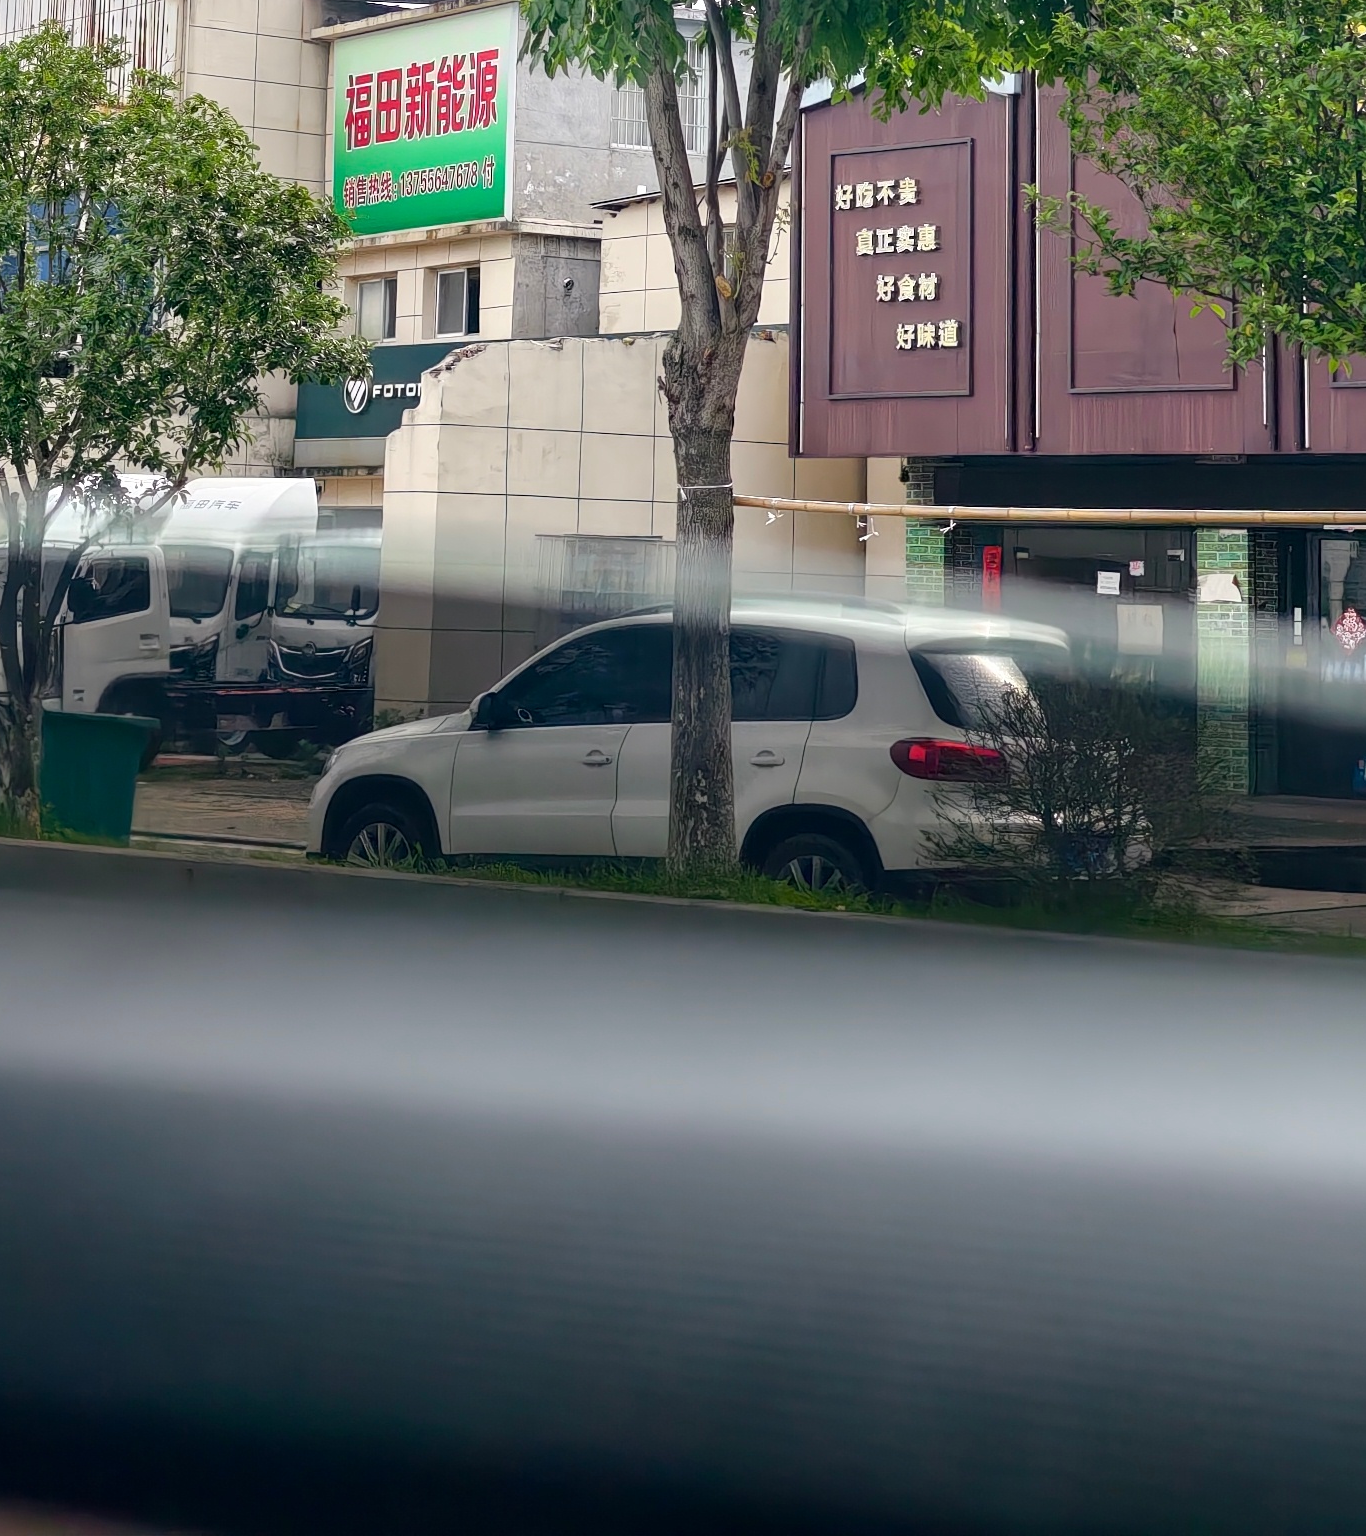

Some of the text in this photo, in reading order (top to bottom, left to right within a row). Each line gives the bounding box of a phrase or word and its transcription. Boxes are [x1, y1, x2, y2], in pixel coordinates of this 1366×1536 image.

[344, 47, 501, 153] 福田新能源
[835, 177, 919, 211] 好吃不贵
[856, 224, 938, 256] 真正实惠
[876, 272, 938, 302] 好食材
[896, 319, 959, 350] 好味道
